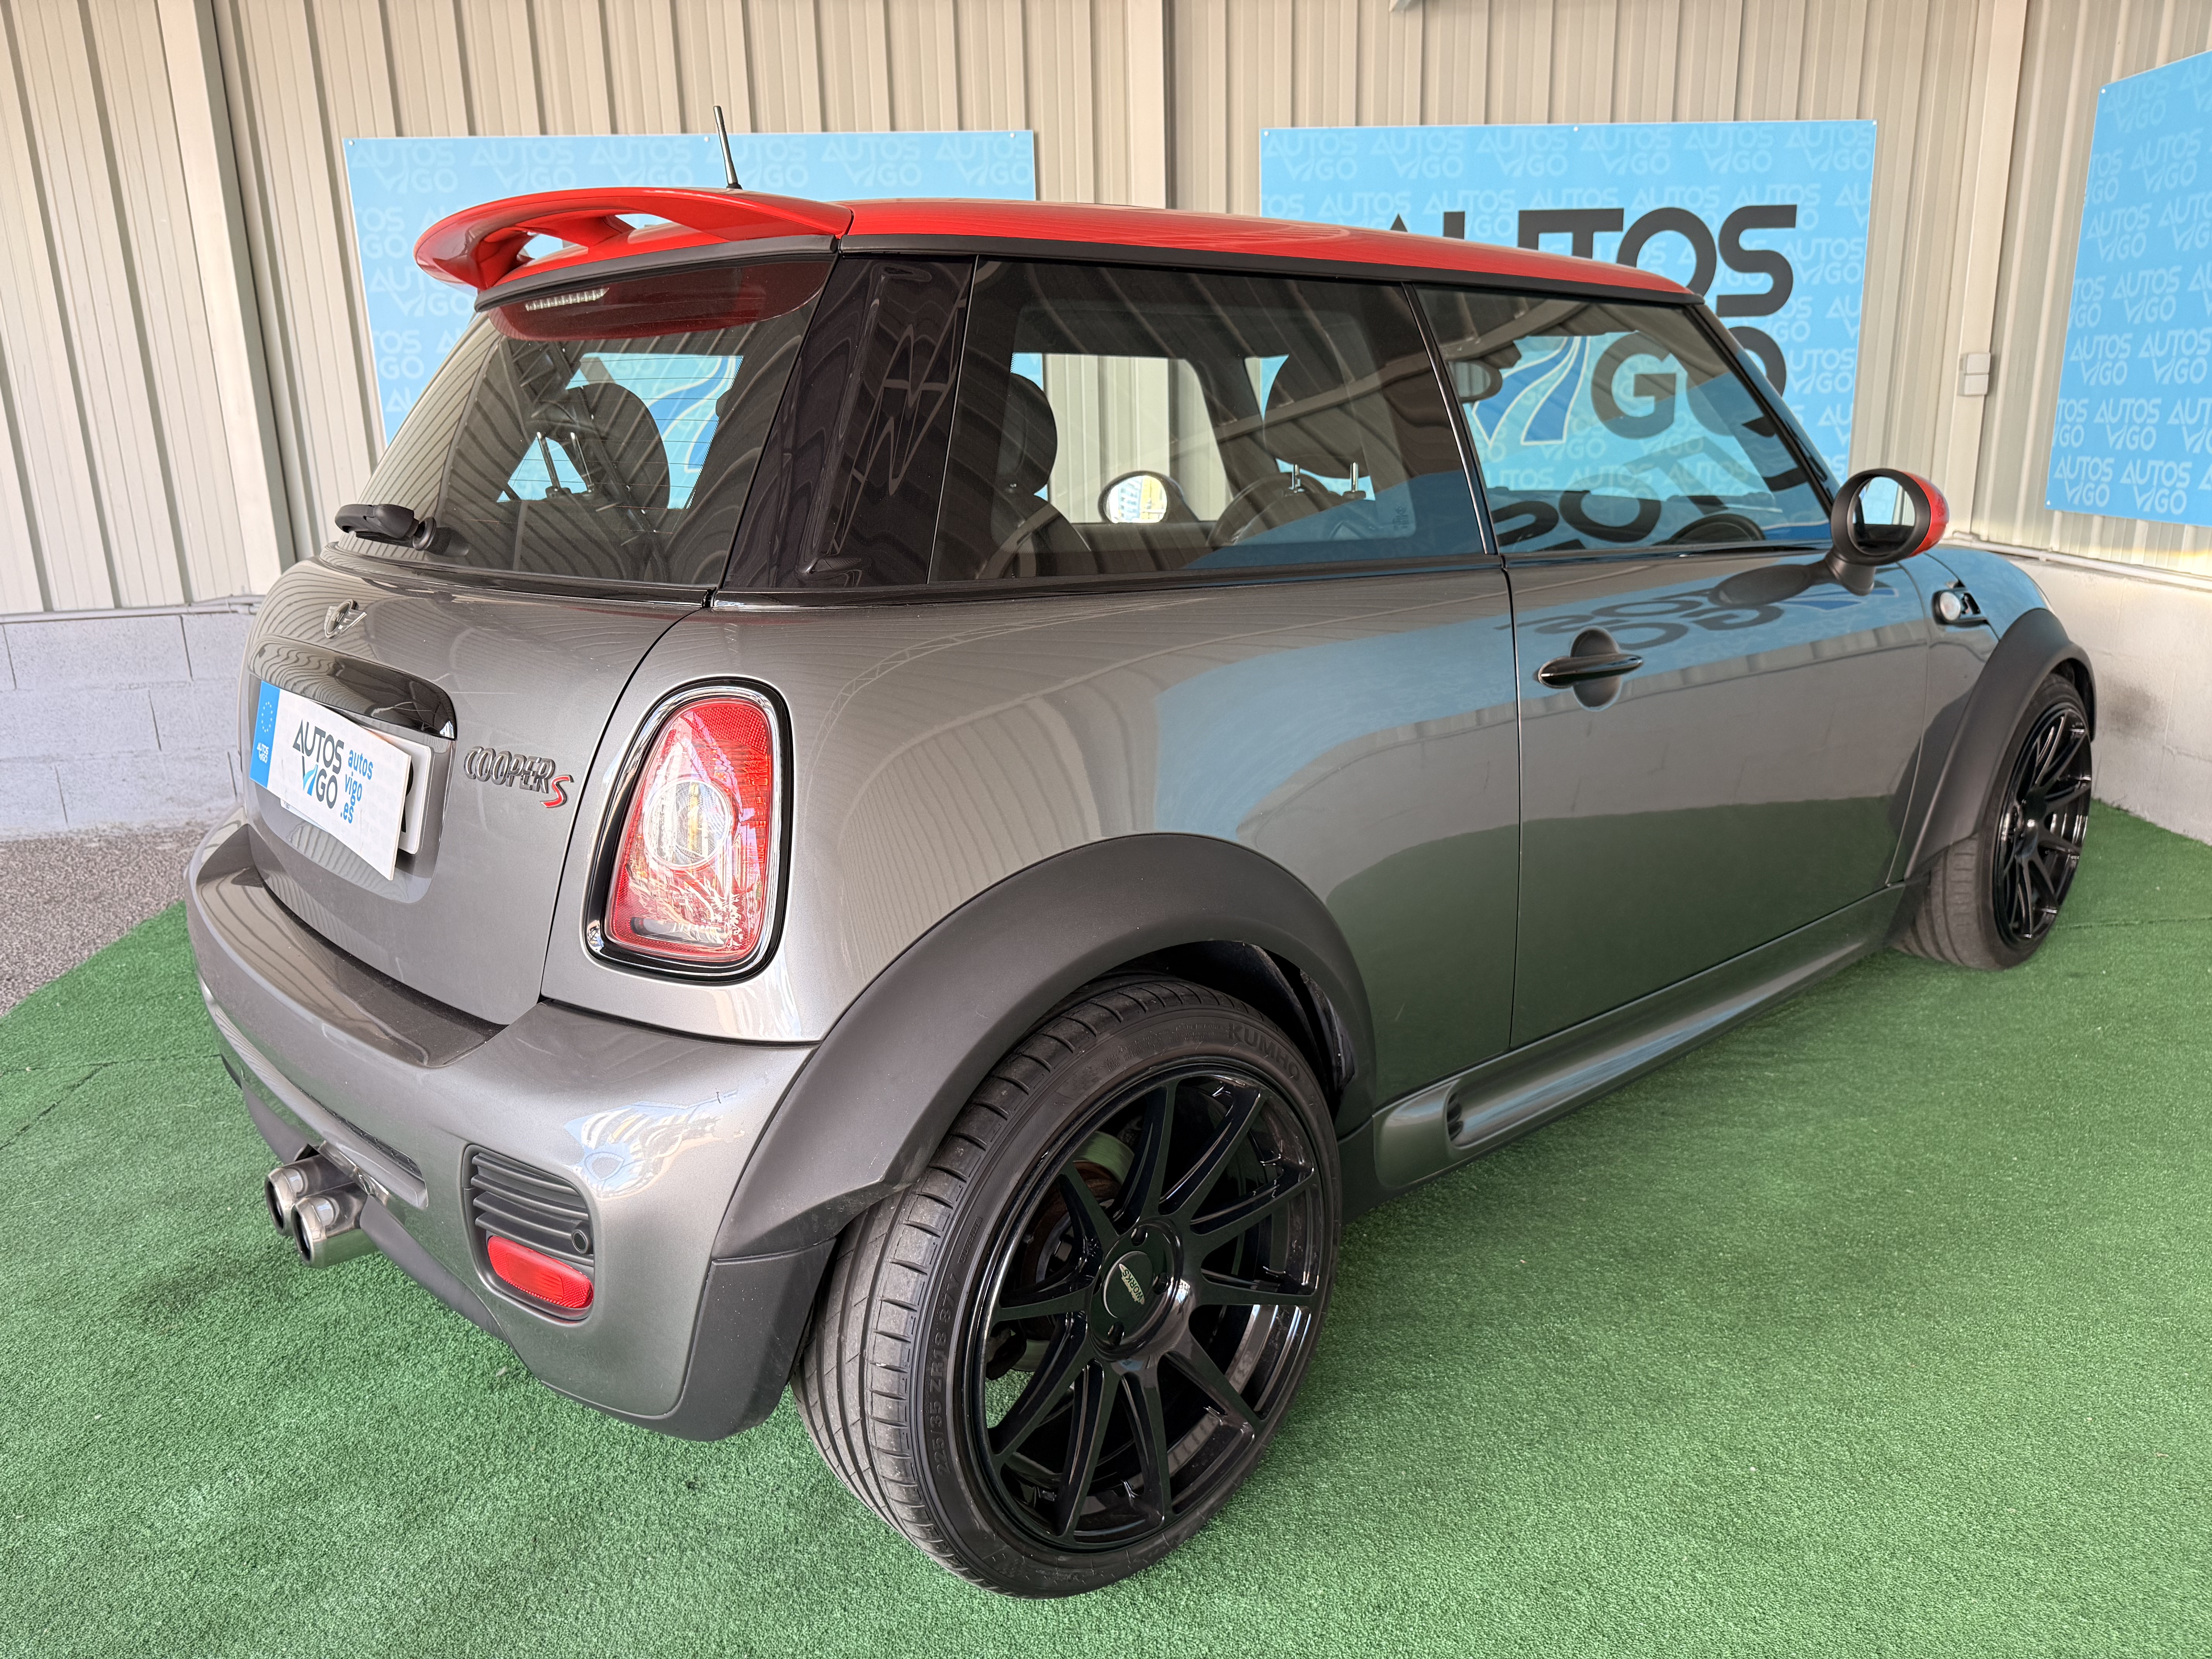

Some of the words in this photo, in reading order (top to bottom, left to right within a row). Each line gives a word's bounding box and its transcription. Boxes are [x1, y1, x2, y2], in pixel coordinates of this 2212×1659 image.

[823, 137, 919, 161] AUTOS
[937, 136, 1029, 160] AUTOS
[1265, 132, 1355, 155] AUTOS
[1374, 131, 1463, 153] AUTOS
[1477, 130, 1566, 151] AUTOS
[1582, 129, 1671, 151] AUTOS
[1686, 126, 1773, 148] AUTOS
[1786, 125, 1870, 147] AUTOS
[2131, 128, 2203, 170] AUTOS
[353, 142, 454, 166] AUTOS
[472, 141, 574, 166] AUTOS
[590, 139, 690, 164] AUTOS
[2145, 160, 2196, 192] VIGO
[1319, 193, 1410, 215] AUTOS
[2087, 204, 2151, 238] AUTOS
[2099, 232, 2145, 261] VIGO
[2112, 266, 2181, 298] AUTOS
[2126, 295, 2175, 323] VIGO
[2070, 333, 2131, 361] AUTOS
[2139, 328, 2212, 357] AUTOS
[2082, 362, 2126, 385] VIGO
[2153, 357, 2206, 383] VIGO
[2095, 398, 2160, 422] AUTOS
[2107, 424, 2155, 450] VIGO
[2055, 455, 2113, 481] AUTOS
[2121, 460, 2191, 487] AUTOS
[2066, 479, 2109, 506] VIGO
[2135, 486, 2186, 514] VIGO
[256, 742, 269, 755] AUTOS
[292, 719, 344, 774] AUTOS
[349, 749, 373, 780] autos
[464, 746, 556, 794] COOPER
[539, 775, 575, 808] S
[301, 755, 338, 809] VIGO
[345, 771, 362, 806] vigo
[340, 802, 354, 824] .es
[1228, 1022, 1300, 1082] KUMHO
[1122, 1269, 1144, 1302] WORKS
[930, 1331, 947, 1393] ZR18
[930, 1400, 948, 1475] 225/35
